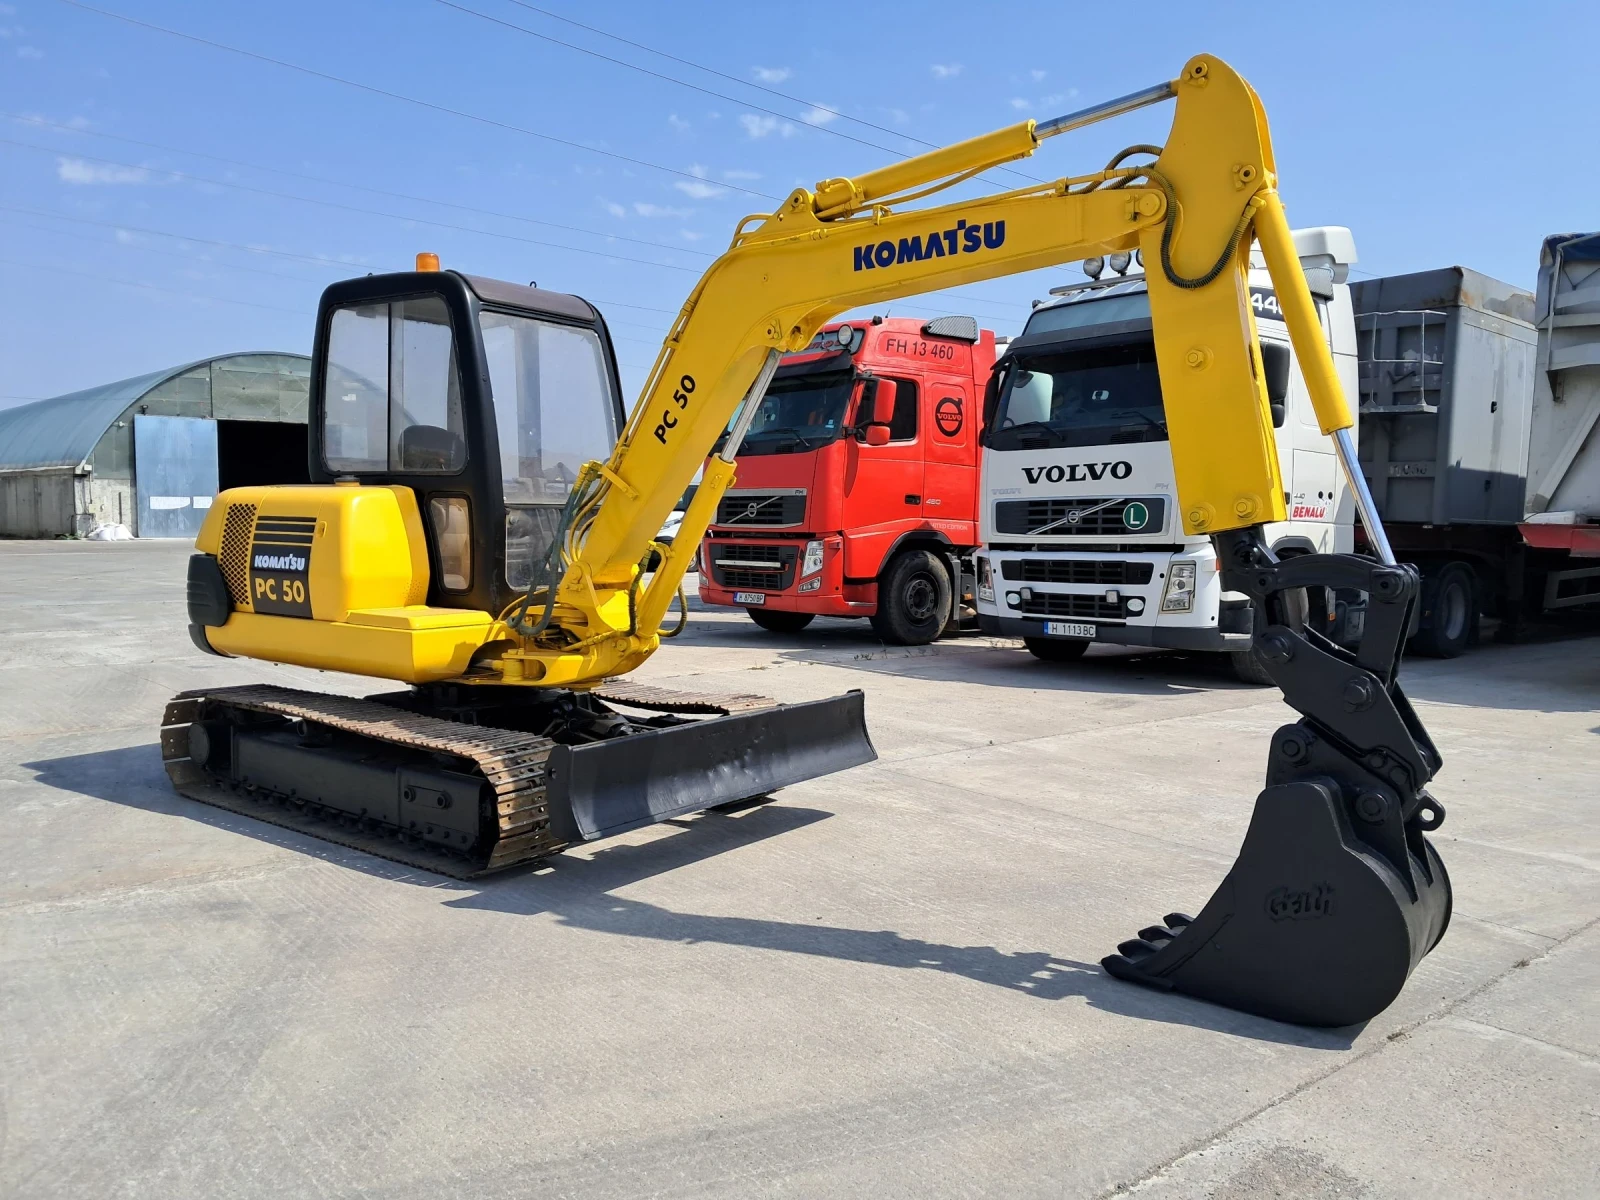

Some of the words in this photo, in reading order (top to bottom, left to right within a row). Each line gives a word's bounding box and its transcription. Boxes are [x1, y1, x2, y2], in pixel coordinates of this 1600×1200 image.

[854, 219, 1005, 271] KOMATSU
[1250, 292, 1283, 315] 44
[886, 338, 907, 354] FH
[912, 341, 927, 357] 13
[931, 344, 954, 360] 460
[654, 409, 678, 445] PC
[672, 374, 696, 410] 50
[1021, 460, 1133, 484] VOLVO
[1129, 507, 1141, 525] L
[1292, 505, 1326, 518] BENALU
[254, 553, 305, 571] KOMATSU
[255, 578, 277, 601] PC
[282, 580, 305, 603] 50
[1051, 623, 1058, 633] H
